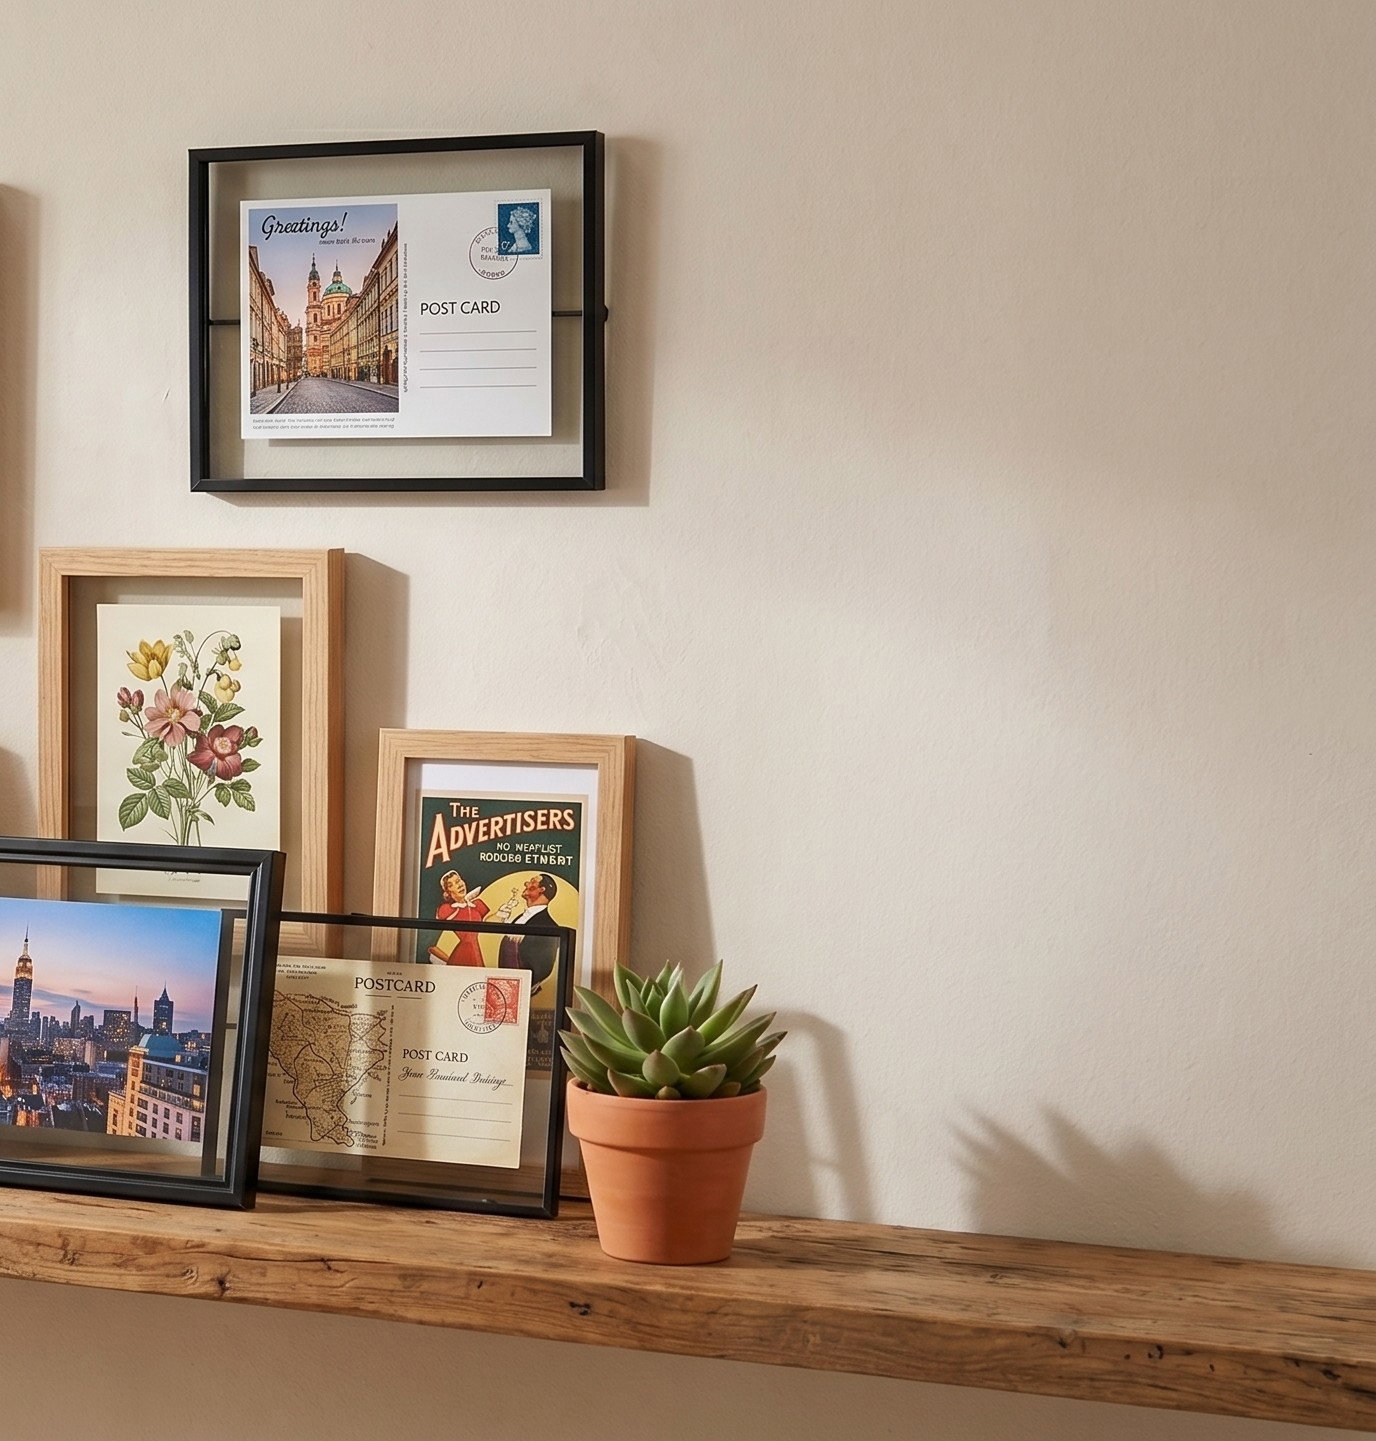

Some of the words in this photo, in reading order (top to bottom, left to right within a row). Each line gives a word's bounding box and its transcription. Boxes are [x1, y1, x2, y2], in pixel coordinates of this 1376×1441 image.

[420, 301, 457, 316] POST
[460, 300, 501, 315] CARD
[449, 802, 480, 818] THE
[425, 809, 575, 869] ADVERTISERS
[354, 976, 436, 994] POSTCARD
[402, 1048, 433, 1061] POST
[435, 1050, 469, 1063] CARD
